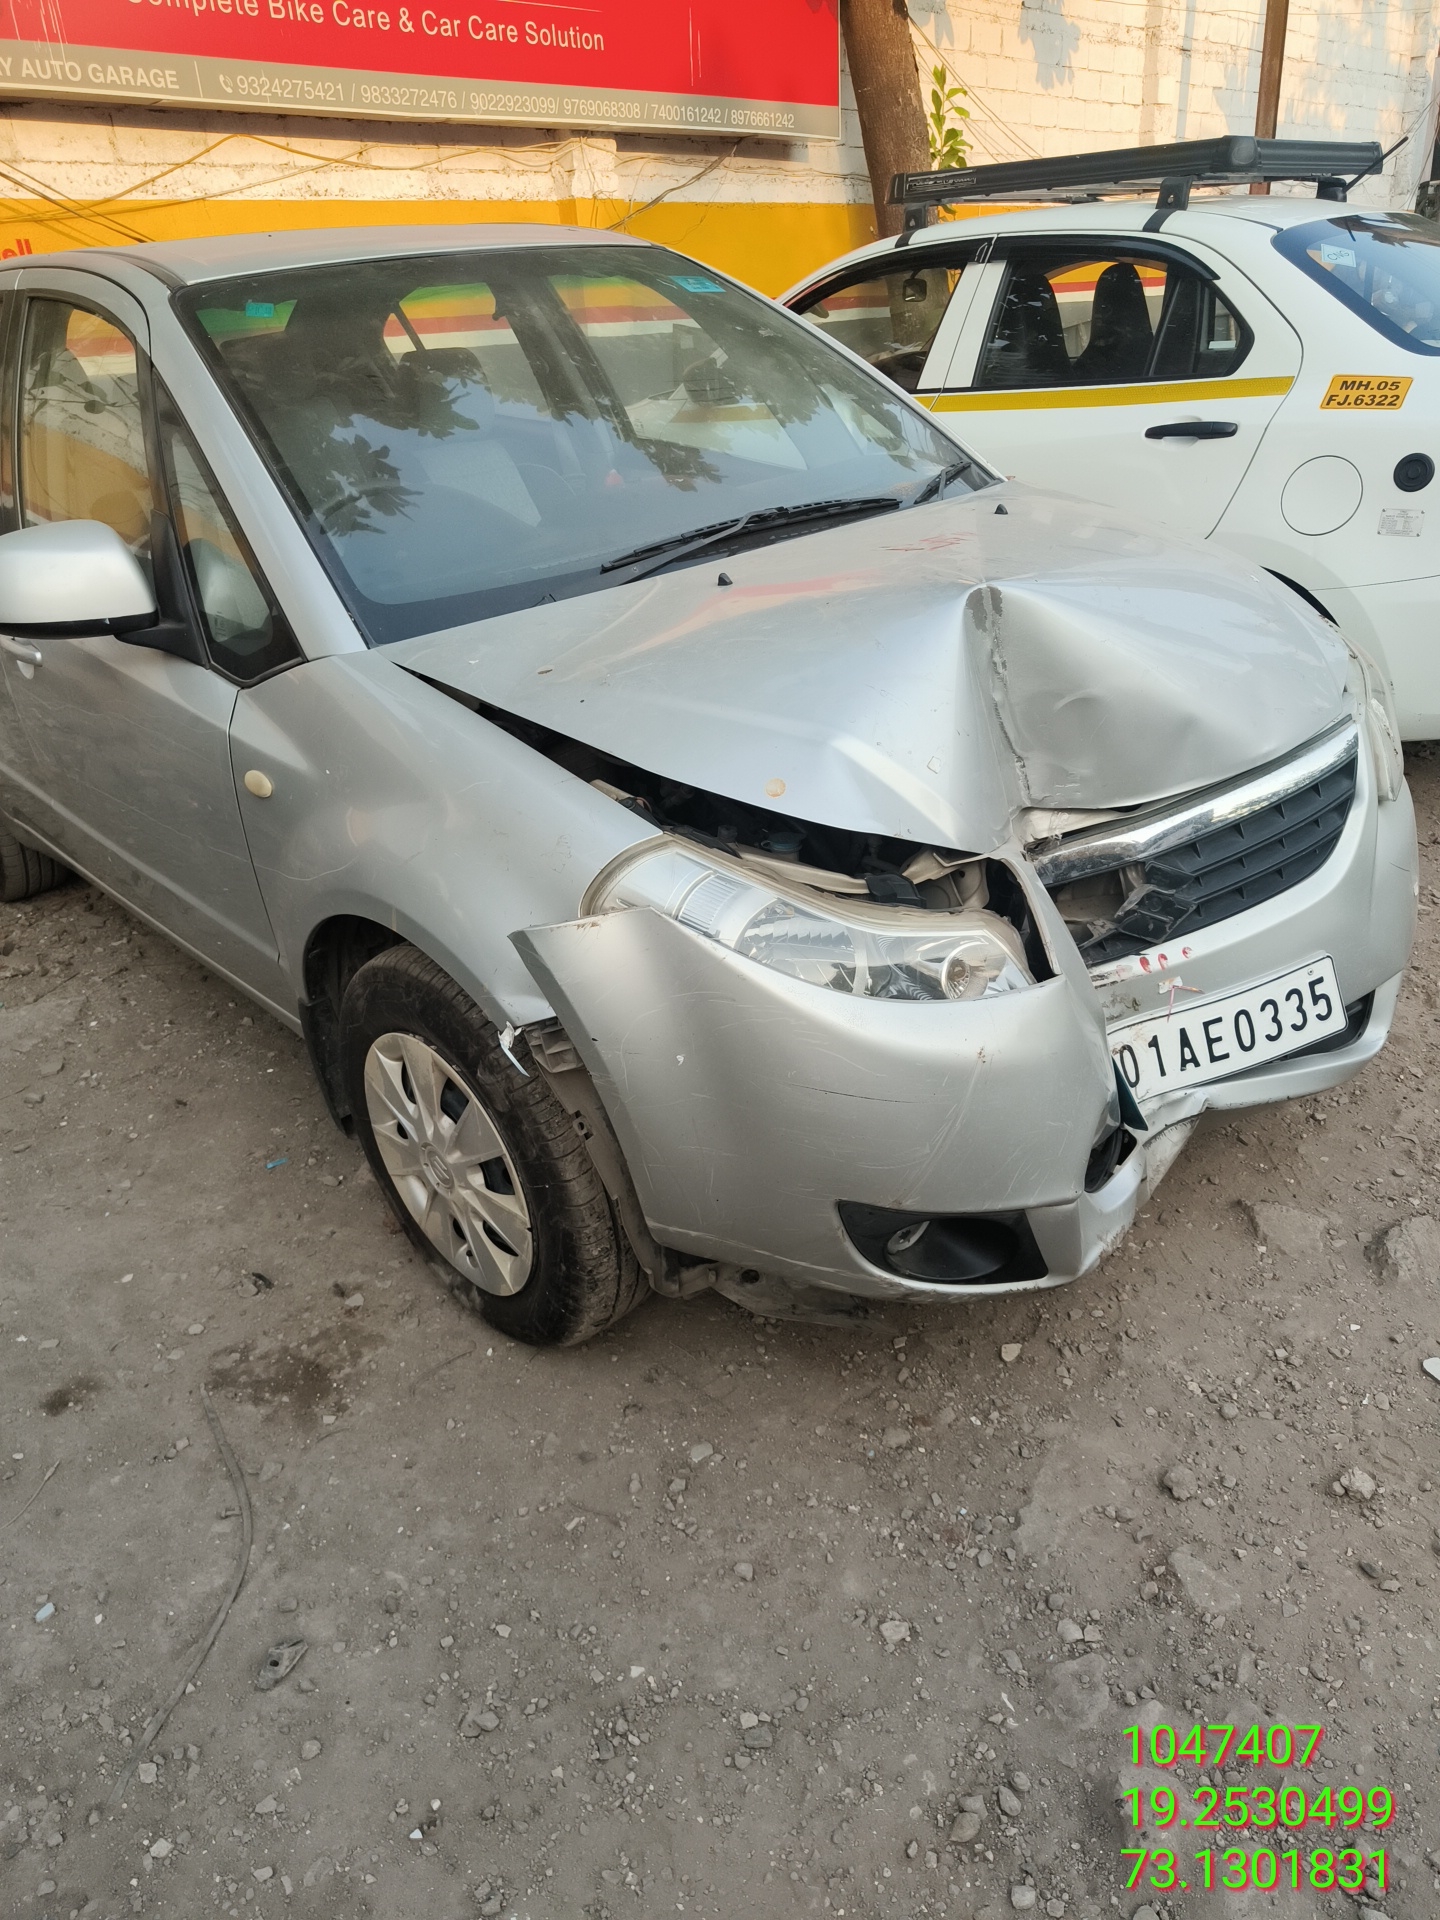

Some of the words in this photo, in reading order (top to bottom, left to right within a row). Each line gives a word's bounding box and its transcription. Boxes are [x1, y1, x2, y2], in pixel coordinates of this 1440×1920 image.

[269, 0, 325, 24] Bike
[332, 0, 391, 31] Care
[398, 7, 415, 34] &
[421, 10, 461, 38] Car
[468, 15, 519, 43] Care
[525, 21, 605, 51] Solution
[0, 57, 13, 77] Y
[22, 58, 82, 82] AUTO
[88, 63, 180, 89] GARAGE
[237, 75, 344, 102] 9324275421
[361, 85, 458, 109] 9833272476
[563, 98, 641, 119] 9769068308
[651, 104, 722, 124] 7400161242
[731, 109, 795, 129] 8976661242
[1325, 394, 1401, 406] FJ.6322
[1339, 380, 1401, 391] MH.05
[1119, 975, 1333, 1089] 01AE0335
